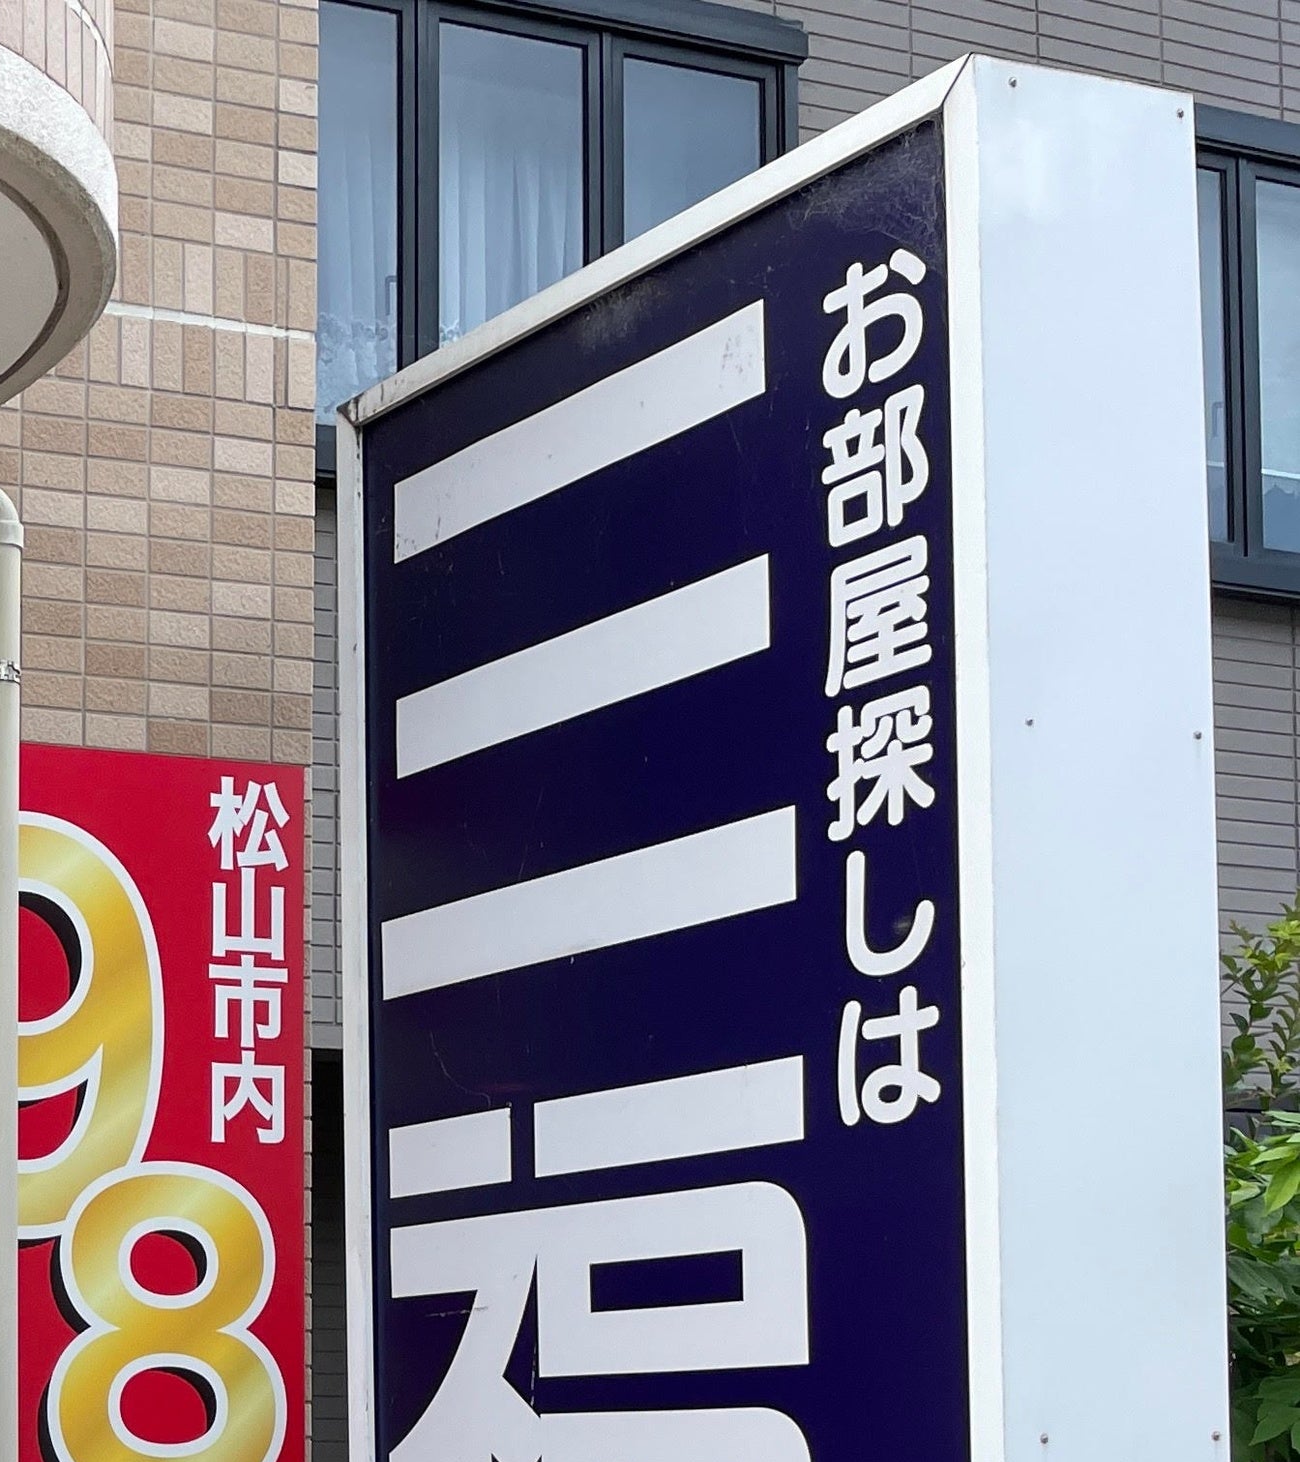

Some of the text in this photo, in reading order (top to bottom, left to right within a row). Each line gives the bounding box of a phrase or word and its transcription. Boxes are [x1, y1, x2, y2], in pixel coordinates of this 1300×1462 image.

[207, 775, 290, 1145] 松山市内
[822, 248, 941, 1128] お部屋探しは
